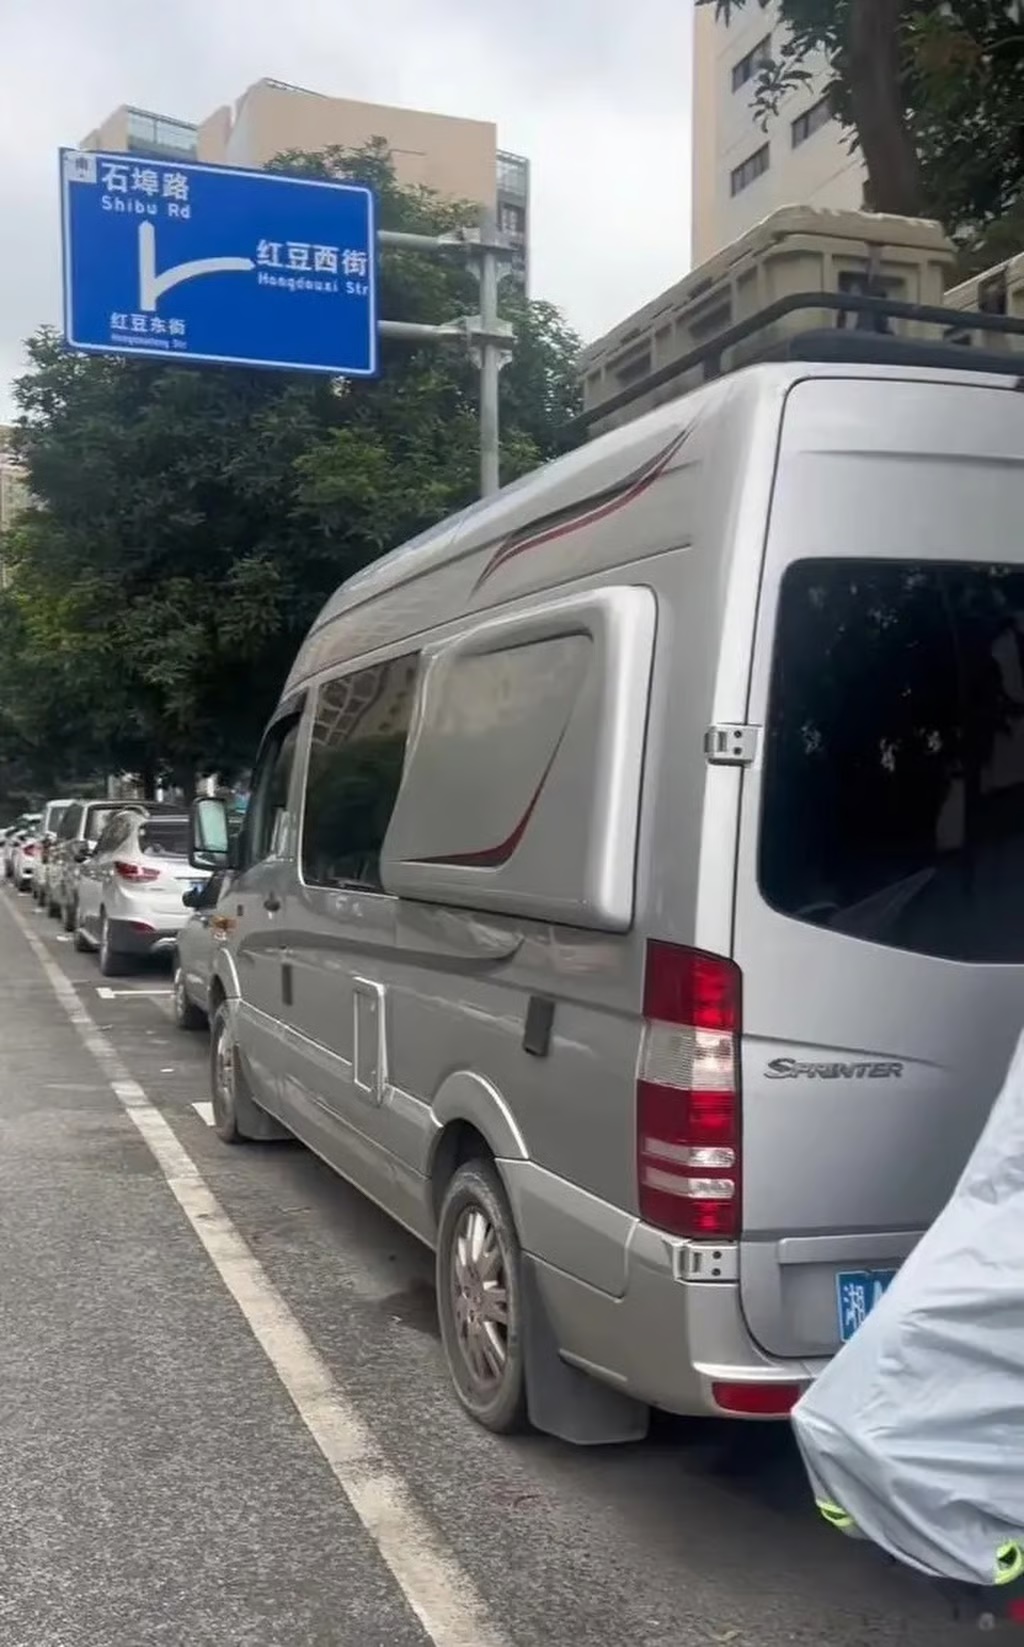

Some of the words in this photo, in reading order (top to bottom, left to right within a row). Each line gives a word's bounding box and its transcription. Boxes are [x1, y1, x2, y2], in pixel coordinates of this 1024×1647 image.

[101, 162, 189, 200] 石埠路
[101, 195, 157, 215] Shibu
[168, 202, 191, 219] Rd
[256, 239, 366, 277] 红豆西街
[345, 281, 368, 295] Str
[110, 312, 186, 335] 红豆东街
[763, 1057, 904, 1079] SPRINTER
